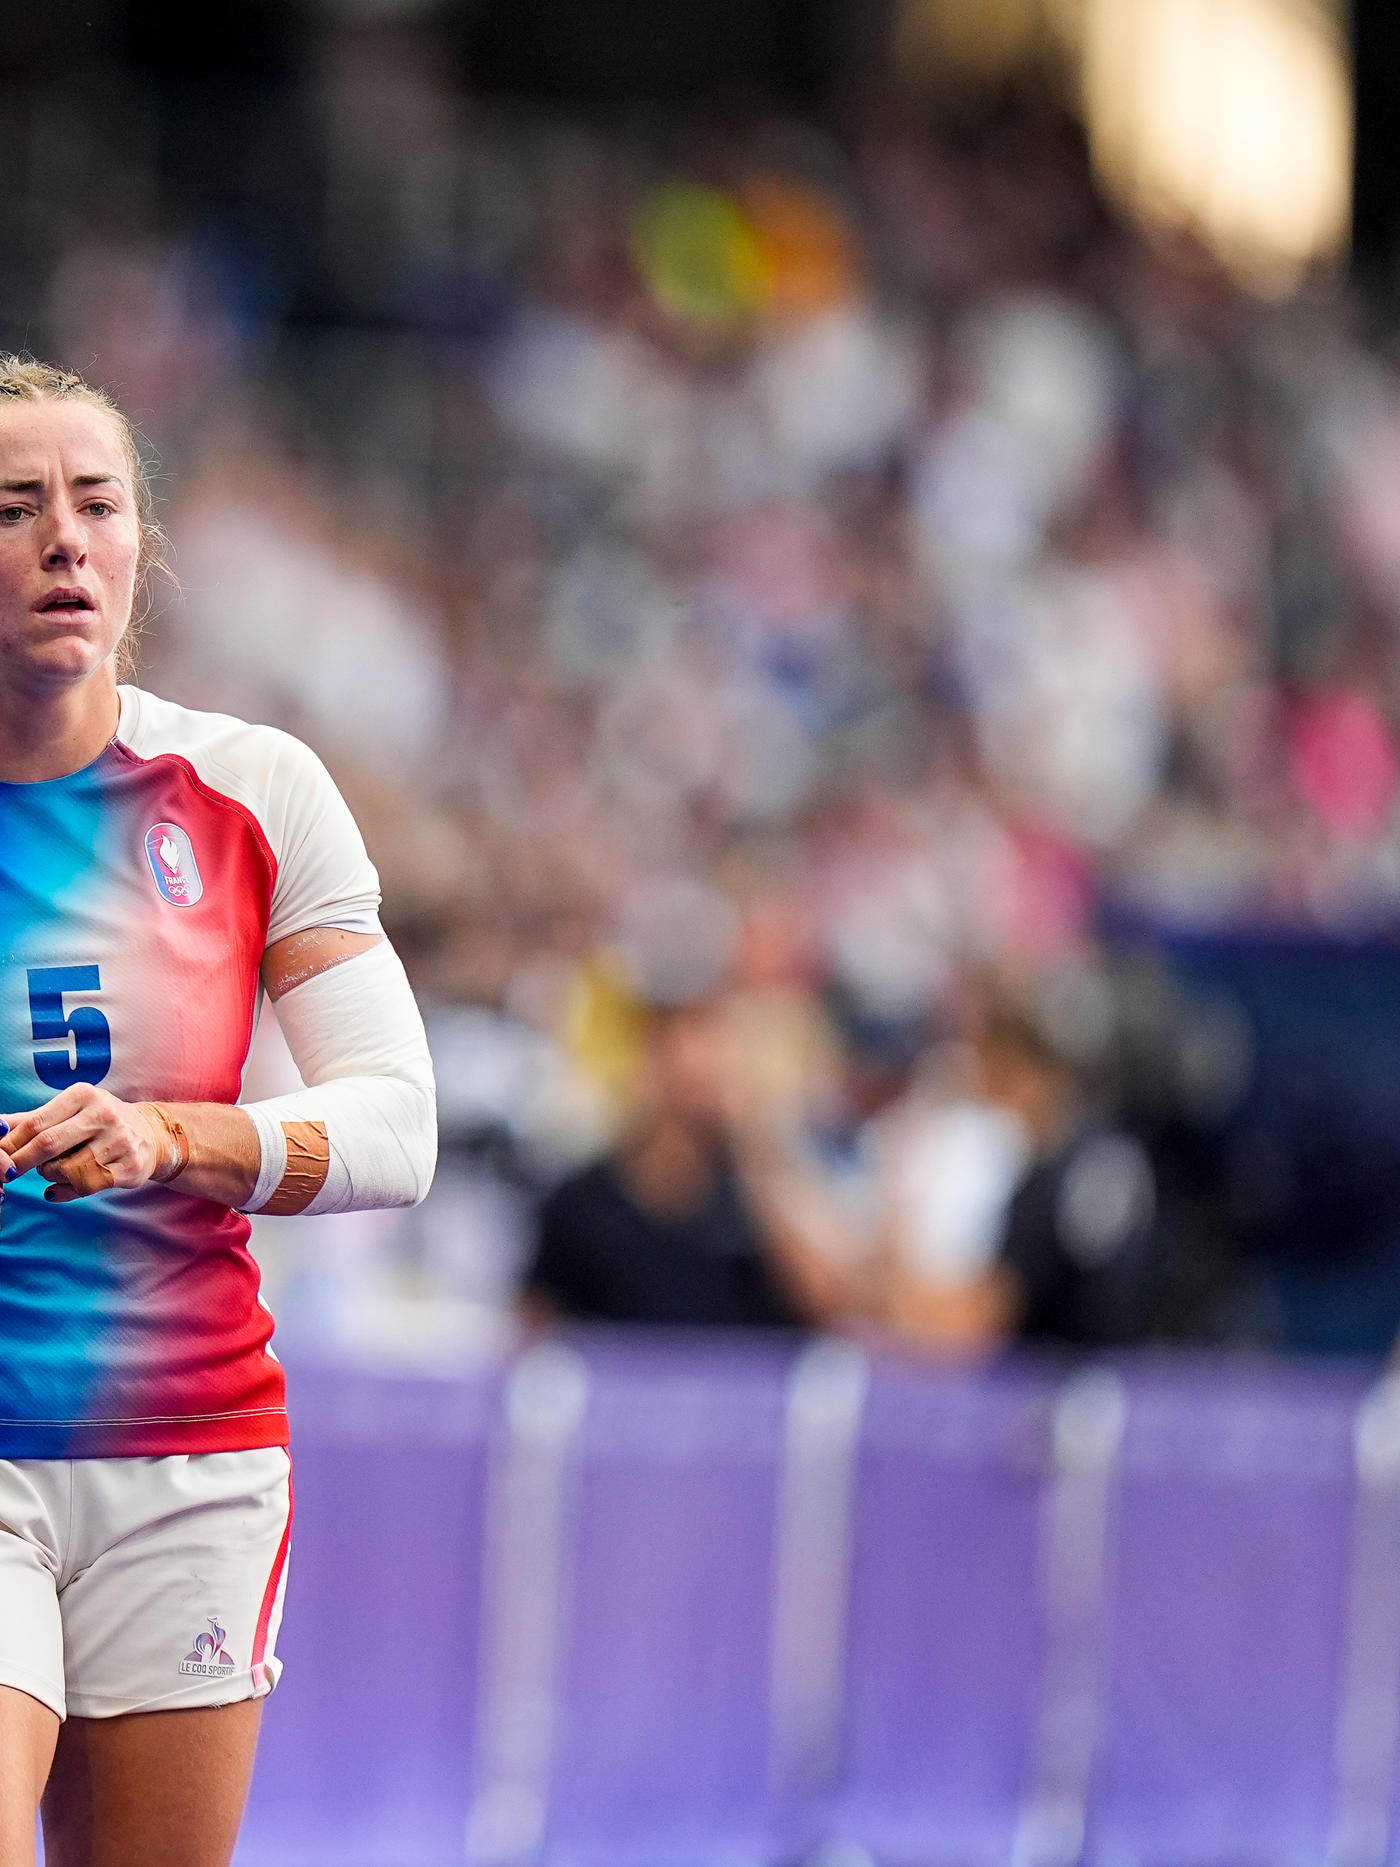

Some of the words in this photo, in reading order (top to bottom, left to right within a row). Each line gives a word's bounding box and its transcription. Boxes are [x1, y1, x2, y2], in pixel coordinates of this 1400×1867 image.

[27, 964, 111, 1091] 5
[181, 1662, 190, 1672] LE
[208, 1665, 235, 1676] SPORTIF
